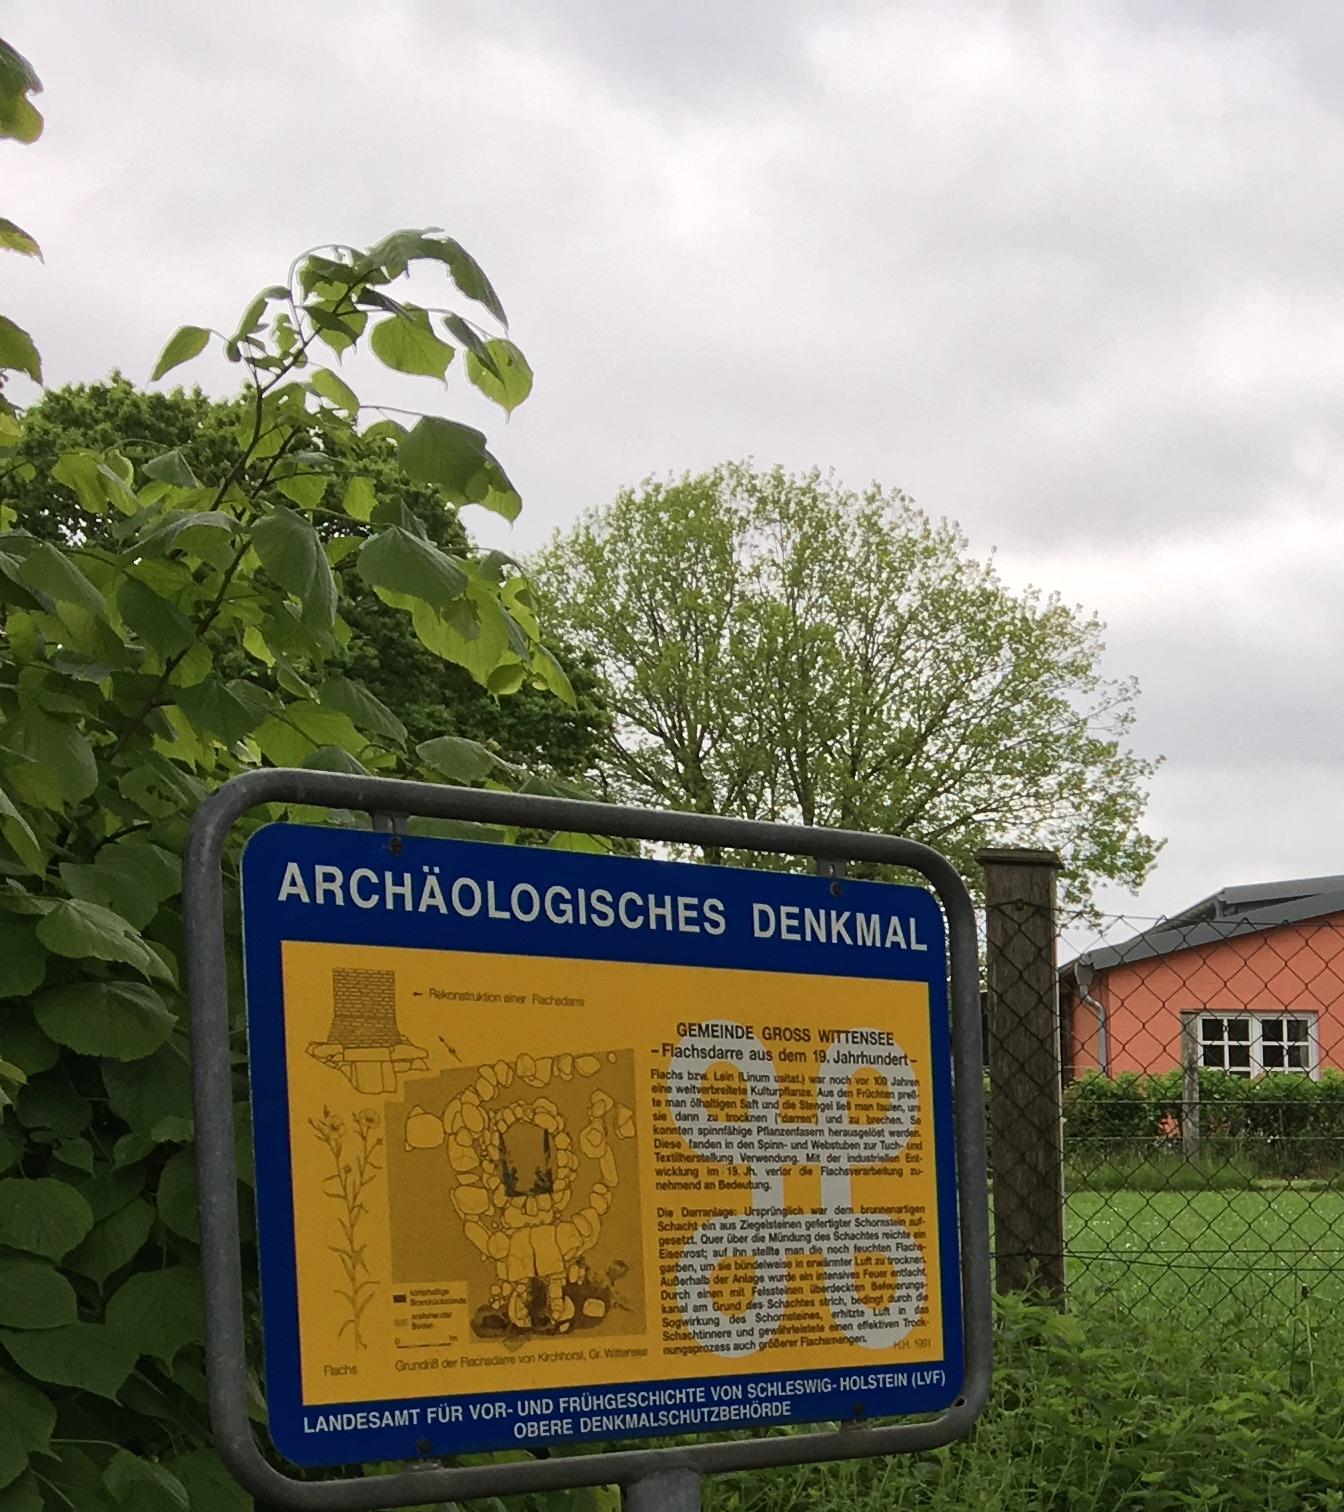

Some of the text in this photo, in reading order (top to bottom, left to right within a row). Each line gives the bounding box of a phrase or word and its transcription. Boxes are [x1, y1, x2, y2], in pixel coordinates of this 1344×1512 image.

[277, 861, 927, 951] ARCHÄOLOGISCHES DENKMAL
[676, 1022, 894, 1046] GEMEINDE GROSS WITTENSEE
[748, 1048, 773, 1061] aus
[777, 1047, 806, 1062] dem
[813, 1048, 831, 1063] 19.
[303, 1406, 420, 1433] LANDESAMT
[426, 1401, 462, 1423] FÜR
[469, 1399, 514, 1420] VOR-
[517, 1396, 553, 1416] UND
[558, 1386, 705, 1413] FRÜHGESCHICHTE
[710, 1383, 742, 1401] VON
[911, 1367, 945, 1387] (LVF)
[513, 1399, 791, 1438] OBERE DENKMALSCHUTZBEHÖRDE
